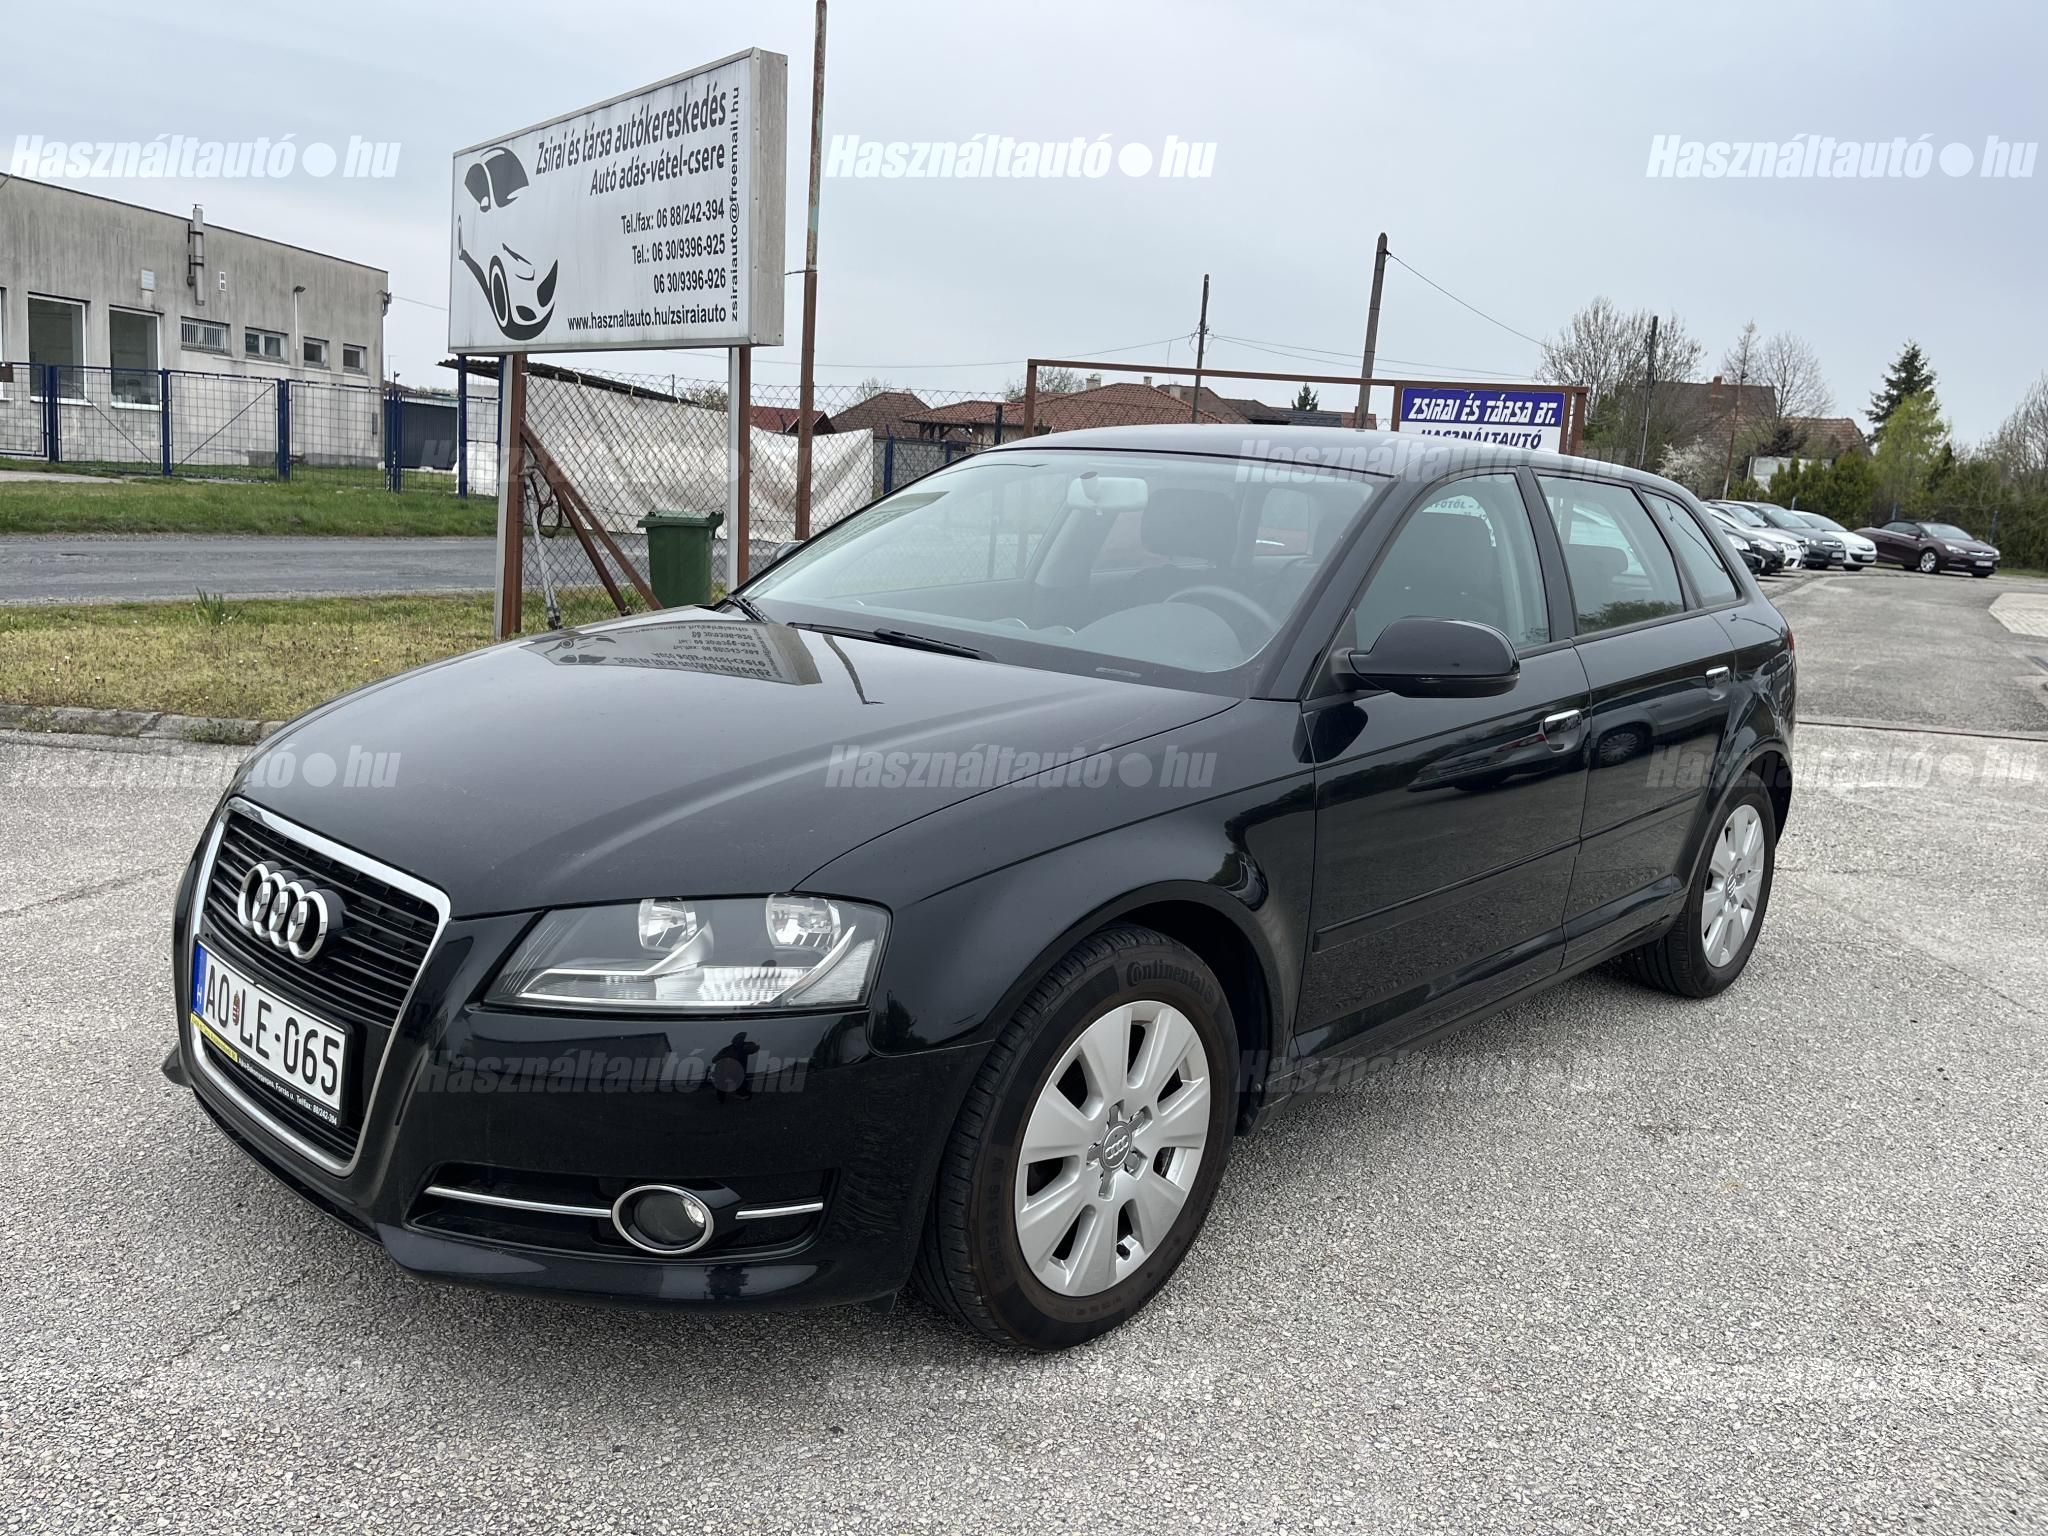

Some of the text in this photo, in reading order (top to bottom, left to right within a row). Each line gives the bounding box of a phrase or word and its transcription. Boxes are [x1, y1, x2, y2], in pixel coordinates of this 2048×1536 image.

[536, 80, 727, 175] Zsirai és társa autókereskedés
[590, 144, 725, 196] Autó adás-vétel-csere
[621, 197, 724, 234] Tel./fax: 06 88/242-394
[729, 87, 740, 322] zsiraiauto@freemail.hu
[632, 233, 726, 264] Tel.: 06 30/9396-925
[653, 267, 726, 294] 06 30/9396-926
[568, 304, 727, 331] www.hasznaltauto.hu/zsiraiauto
[1408, 397, 1460, 421] ZSIRAI
[1461, 393, 1481, 421] ÉS
[1484, 394, 1533, 423] TÁRSA
[205, 964, 230, 1028] AO
